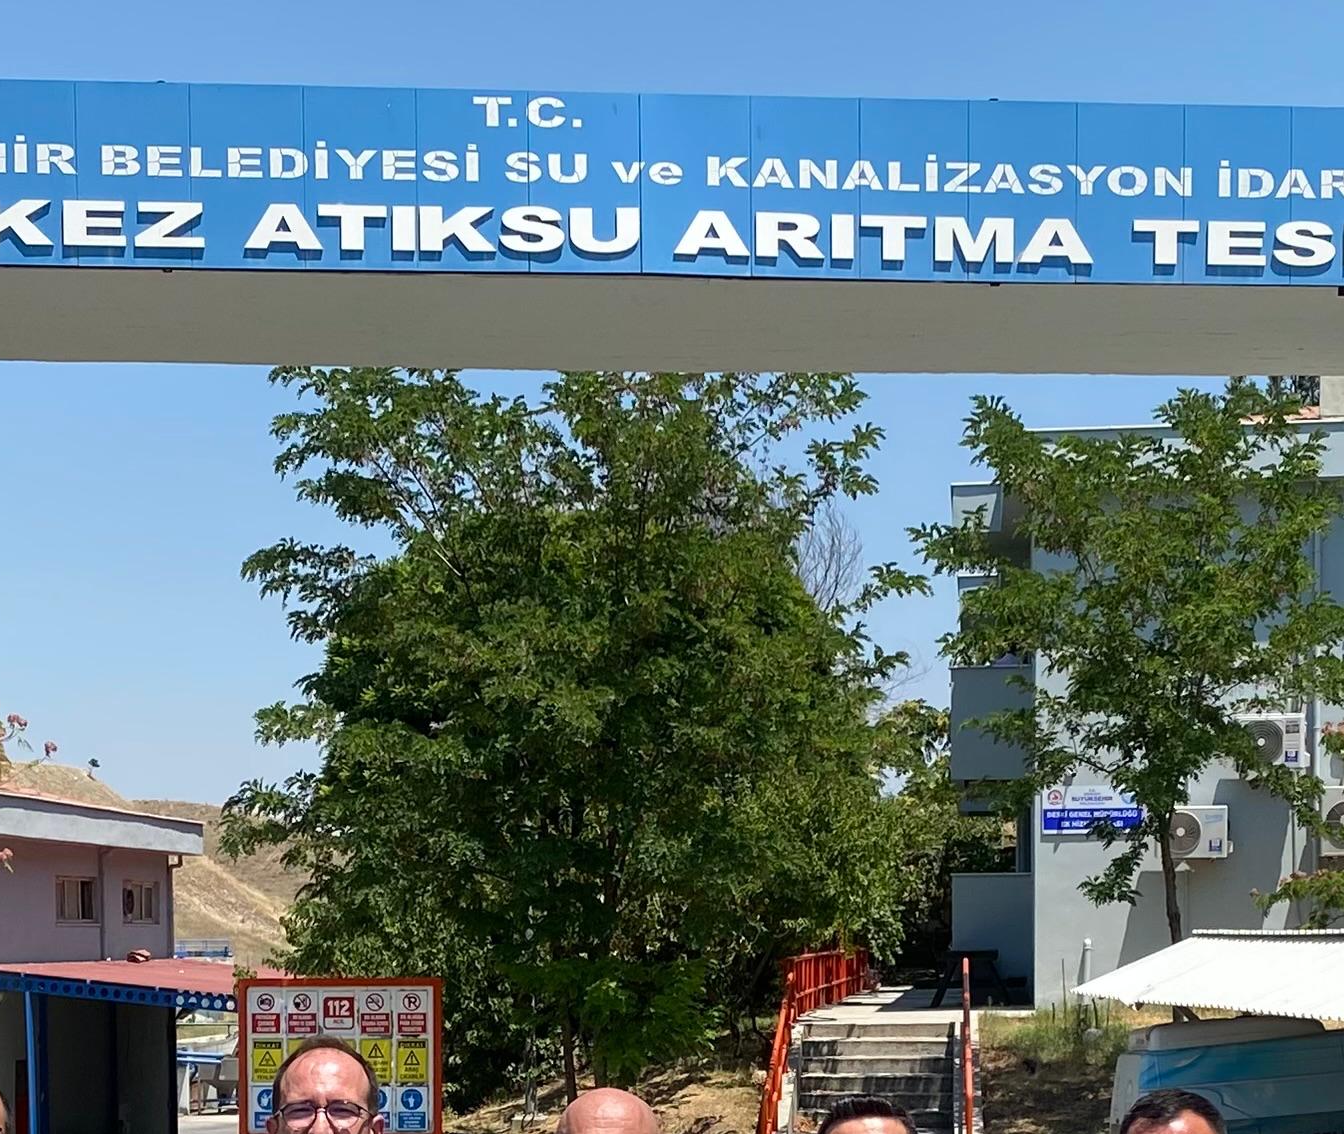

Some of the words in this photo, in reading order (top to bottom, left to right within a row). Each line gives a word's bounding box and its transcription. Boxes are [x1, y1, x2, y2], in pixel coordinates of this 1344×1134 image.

[473, 95, 582, 128] T.C.
[101, 140, 479, 183] BELEDİYESİ
[505, 151, 588, 184] SU
[611, 161, 683, 185] ve
[706, 153, 1193, 198] KANALİZASYON
[244, 202, 642, 254] ATIKSU
[673, 209, 1094, 265] ARITMA
[327, 999, 351, 1017] 112
